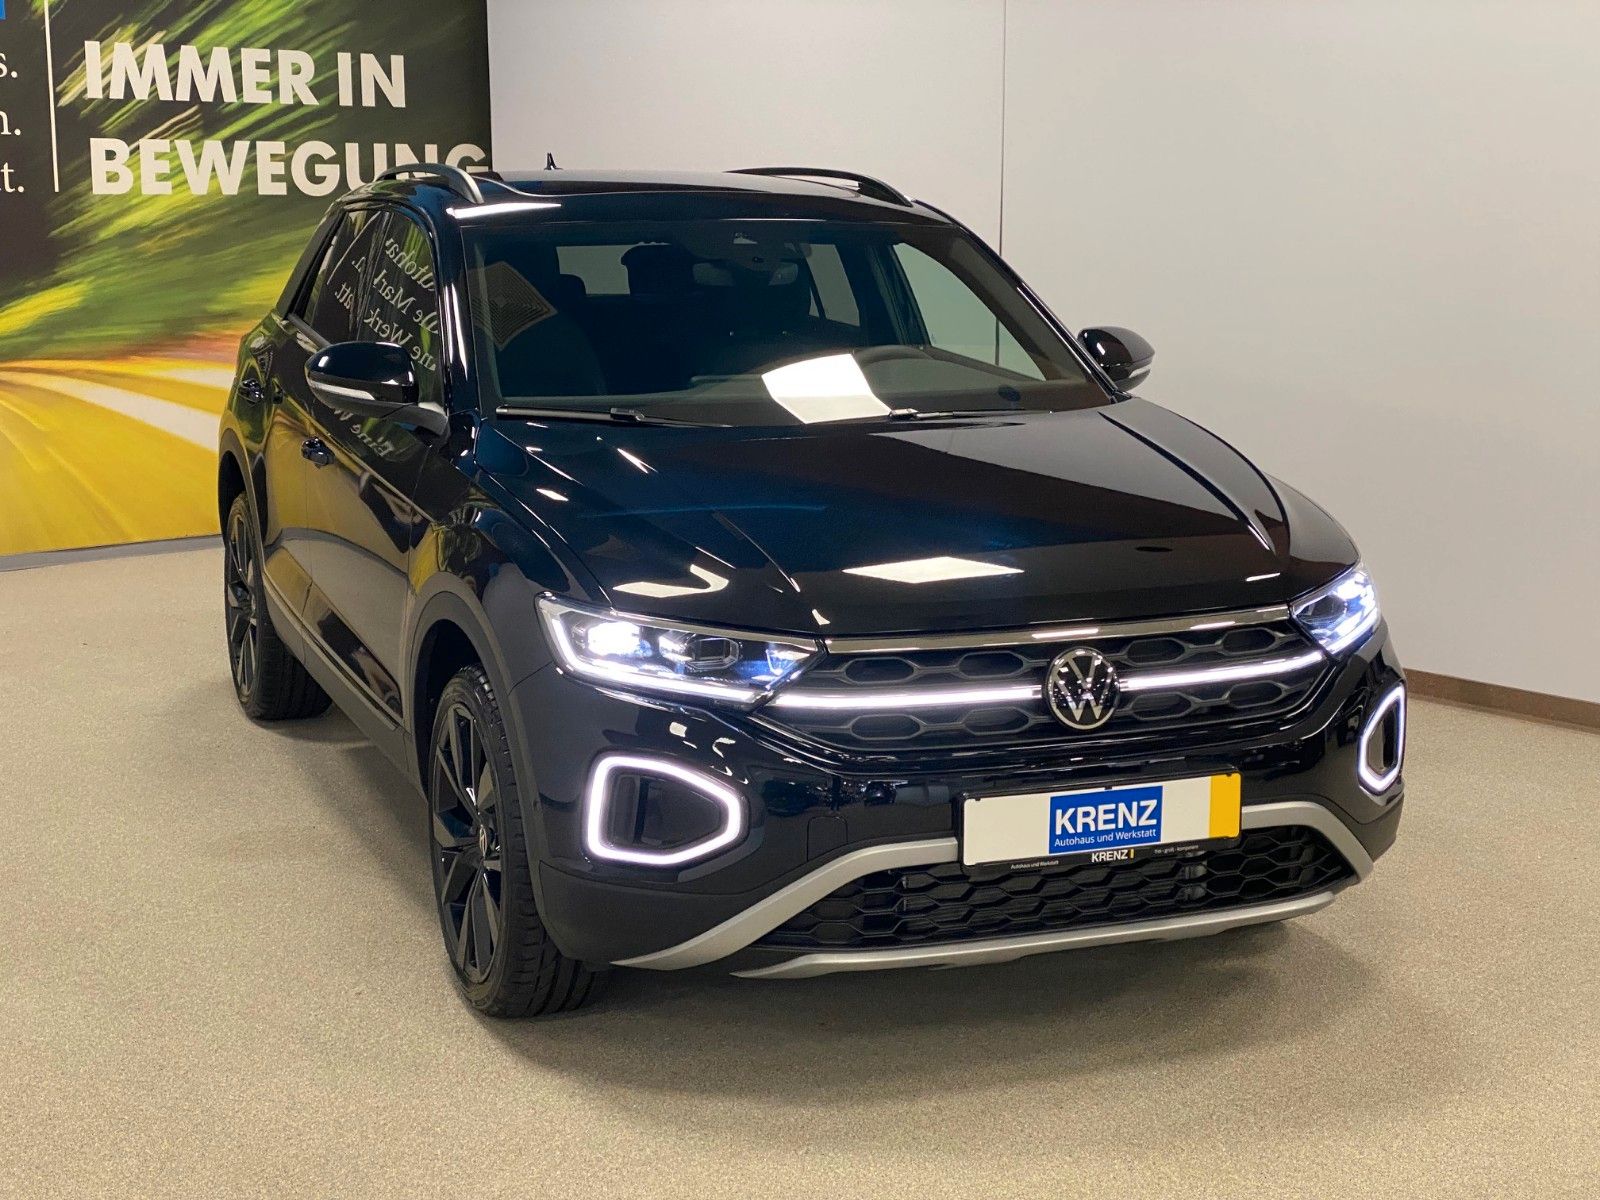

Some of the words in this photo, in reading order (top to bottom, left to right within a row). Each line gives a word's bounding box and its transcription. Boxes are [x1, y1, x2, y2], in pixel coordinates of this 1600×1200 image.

[84, 40, 319, 105] IMMER
[337, 52, 406, 108] IN
[1055, 799, 1158, 835] KRENZ
[1054, 835, 1095, 847] Autohaus
[1097, 833, 1114, 843] und
[1116, 829, 1157, 841] Werkstatt
[1091, 850, 1129, 863] KRENZ
